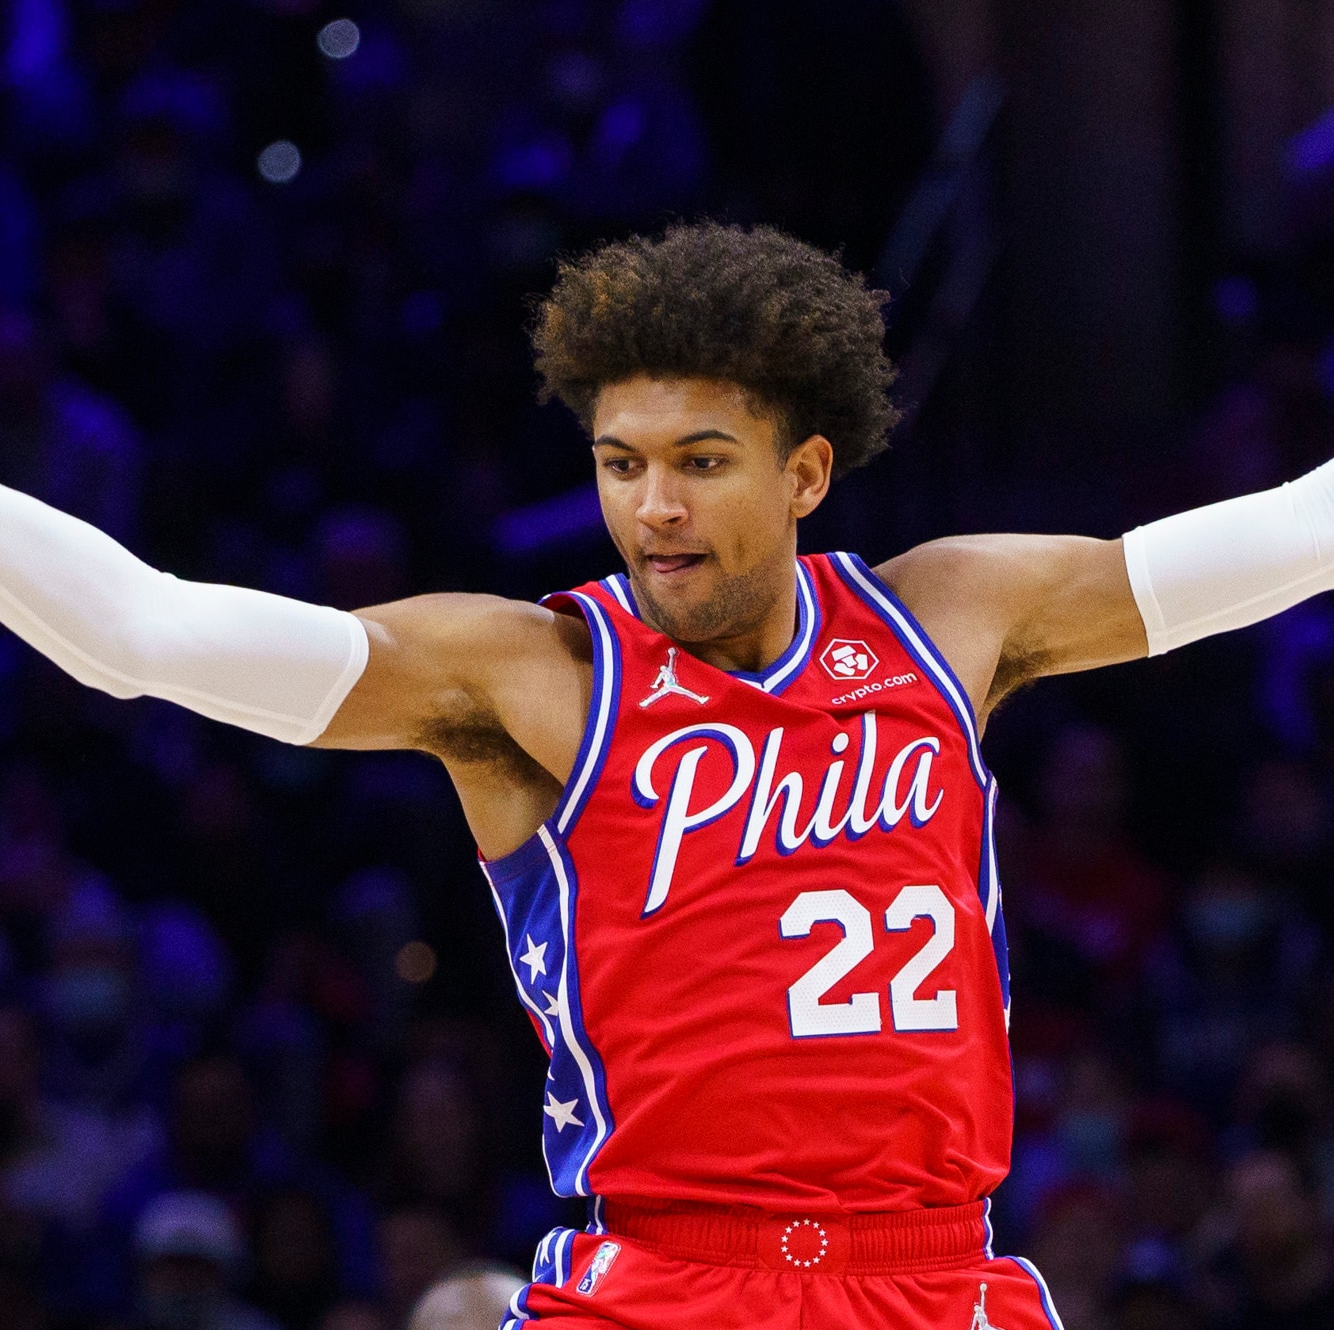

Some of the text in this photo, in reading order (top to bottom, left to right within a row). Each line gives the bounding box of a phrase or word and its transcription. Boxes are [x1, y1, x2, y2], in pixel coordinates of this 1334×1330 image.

[831, 672, 918, 705] crypto.com
[631, 709, 943, 919] Phila
[779, 885, 959, 1039] 22
